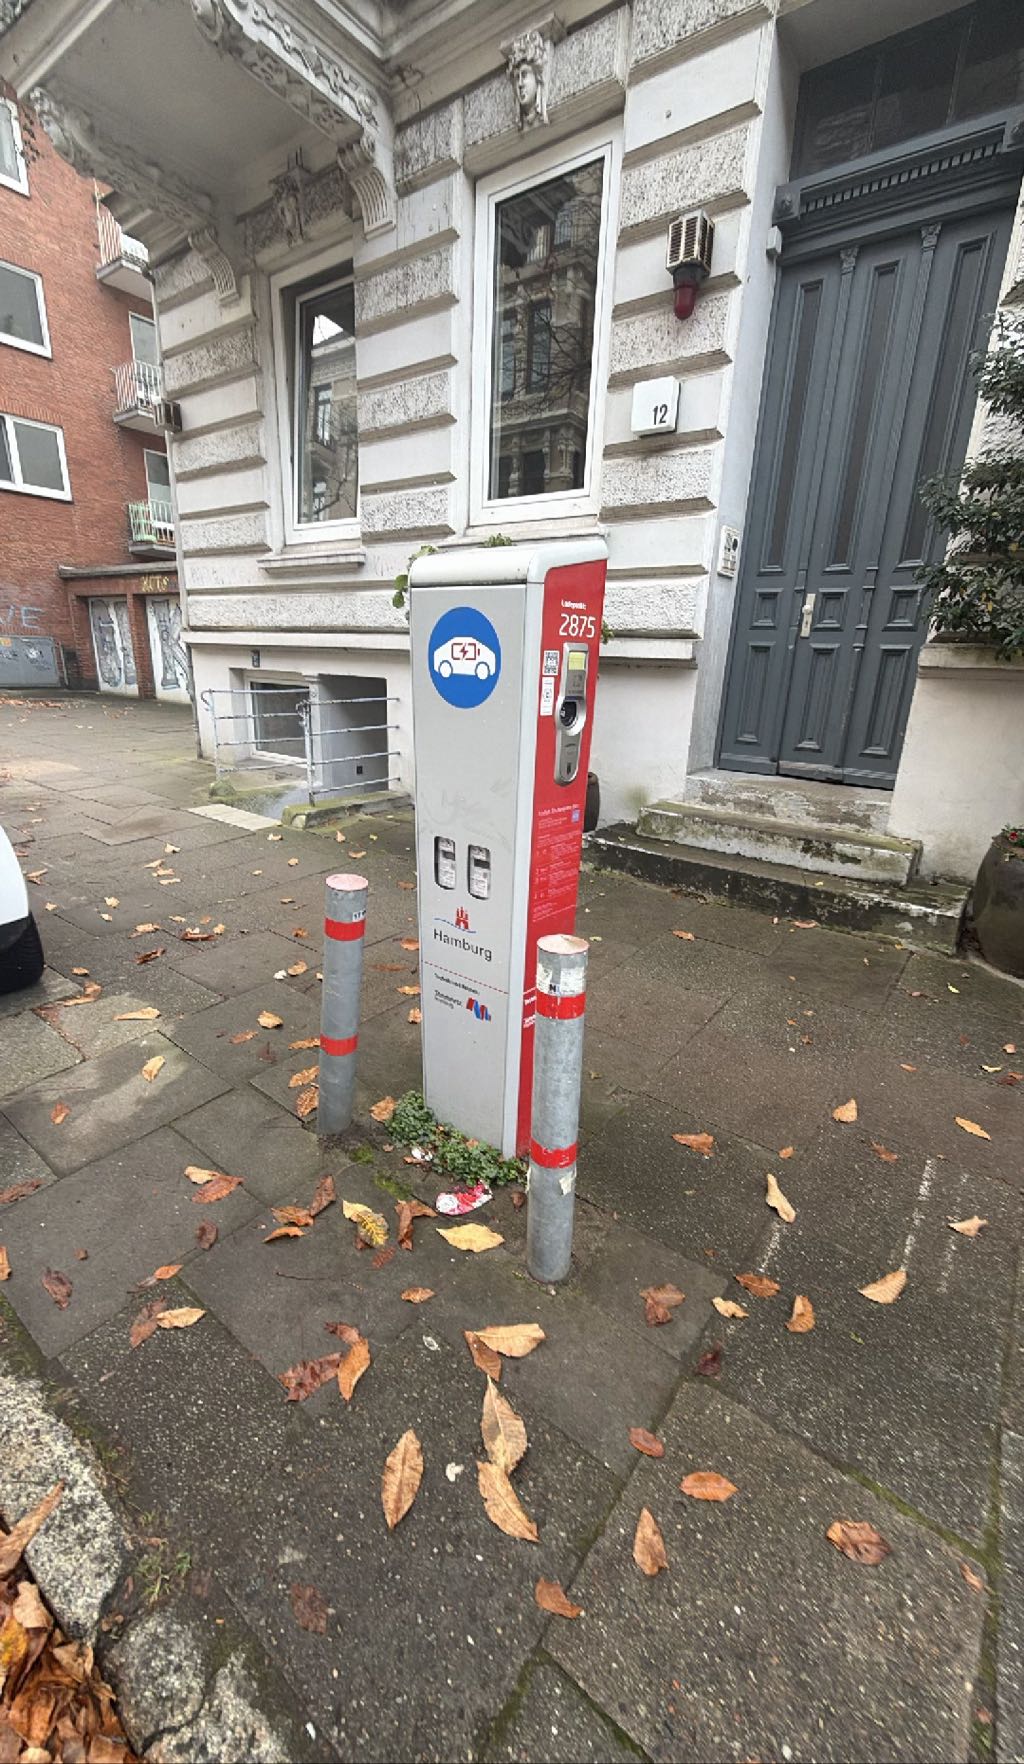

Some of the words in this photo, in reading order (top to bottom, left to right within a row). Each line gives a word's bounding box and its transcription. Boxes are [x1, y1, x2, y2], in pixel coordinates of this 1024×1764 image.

[653, 404, 668, 425] 12
[559, 613, 596, 638] 2875
[434, 928, 492, 962] Hamburg
